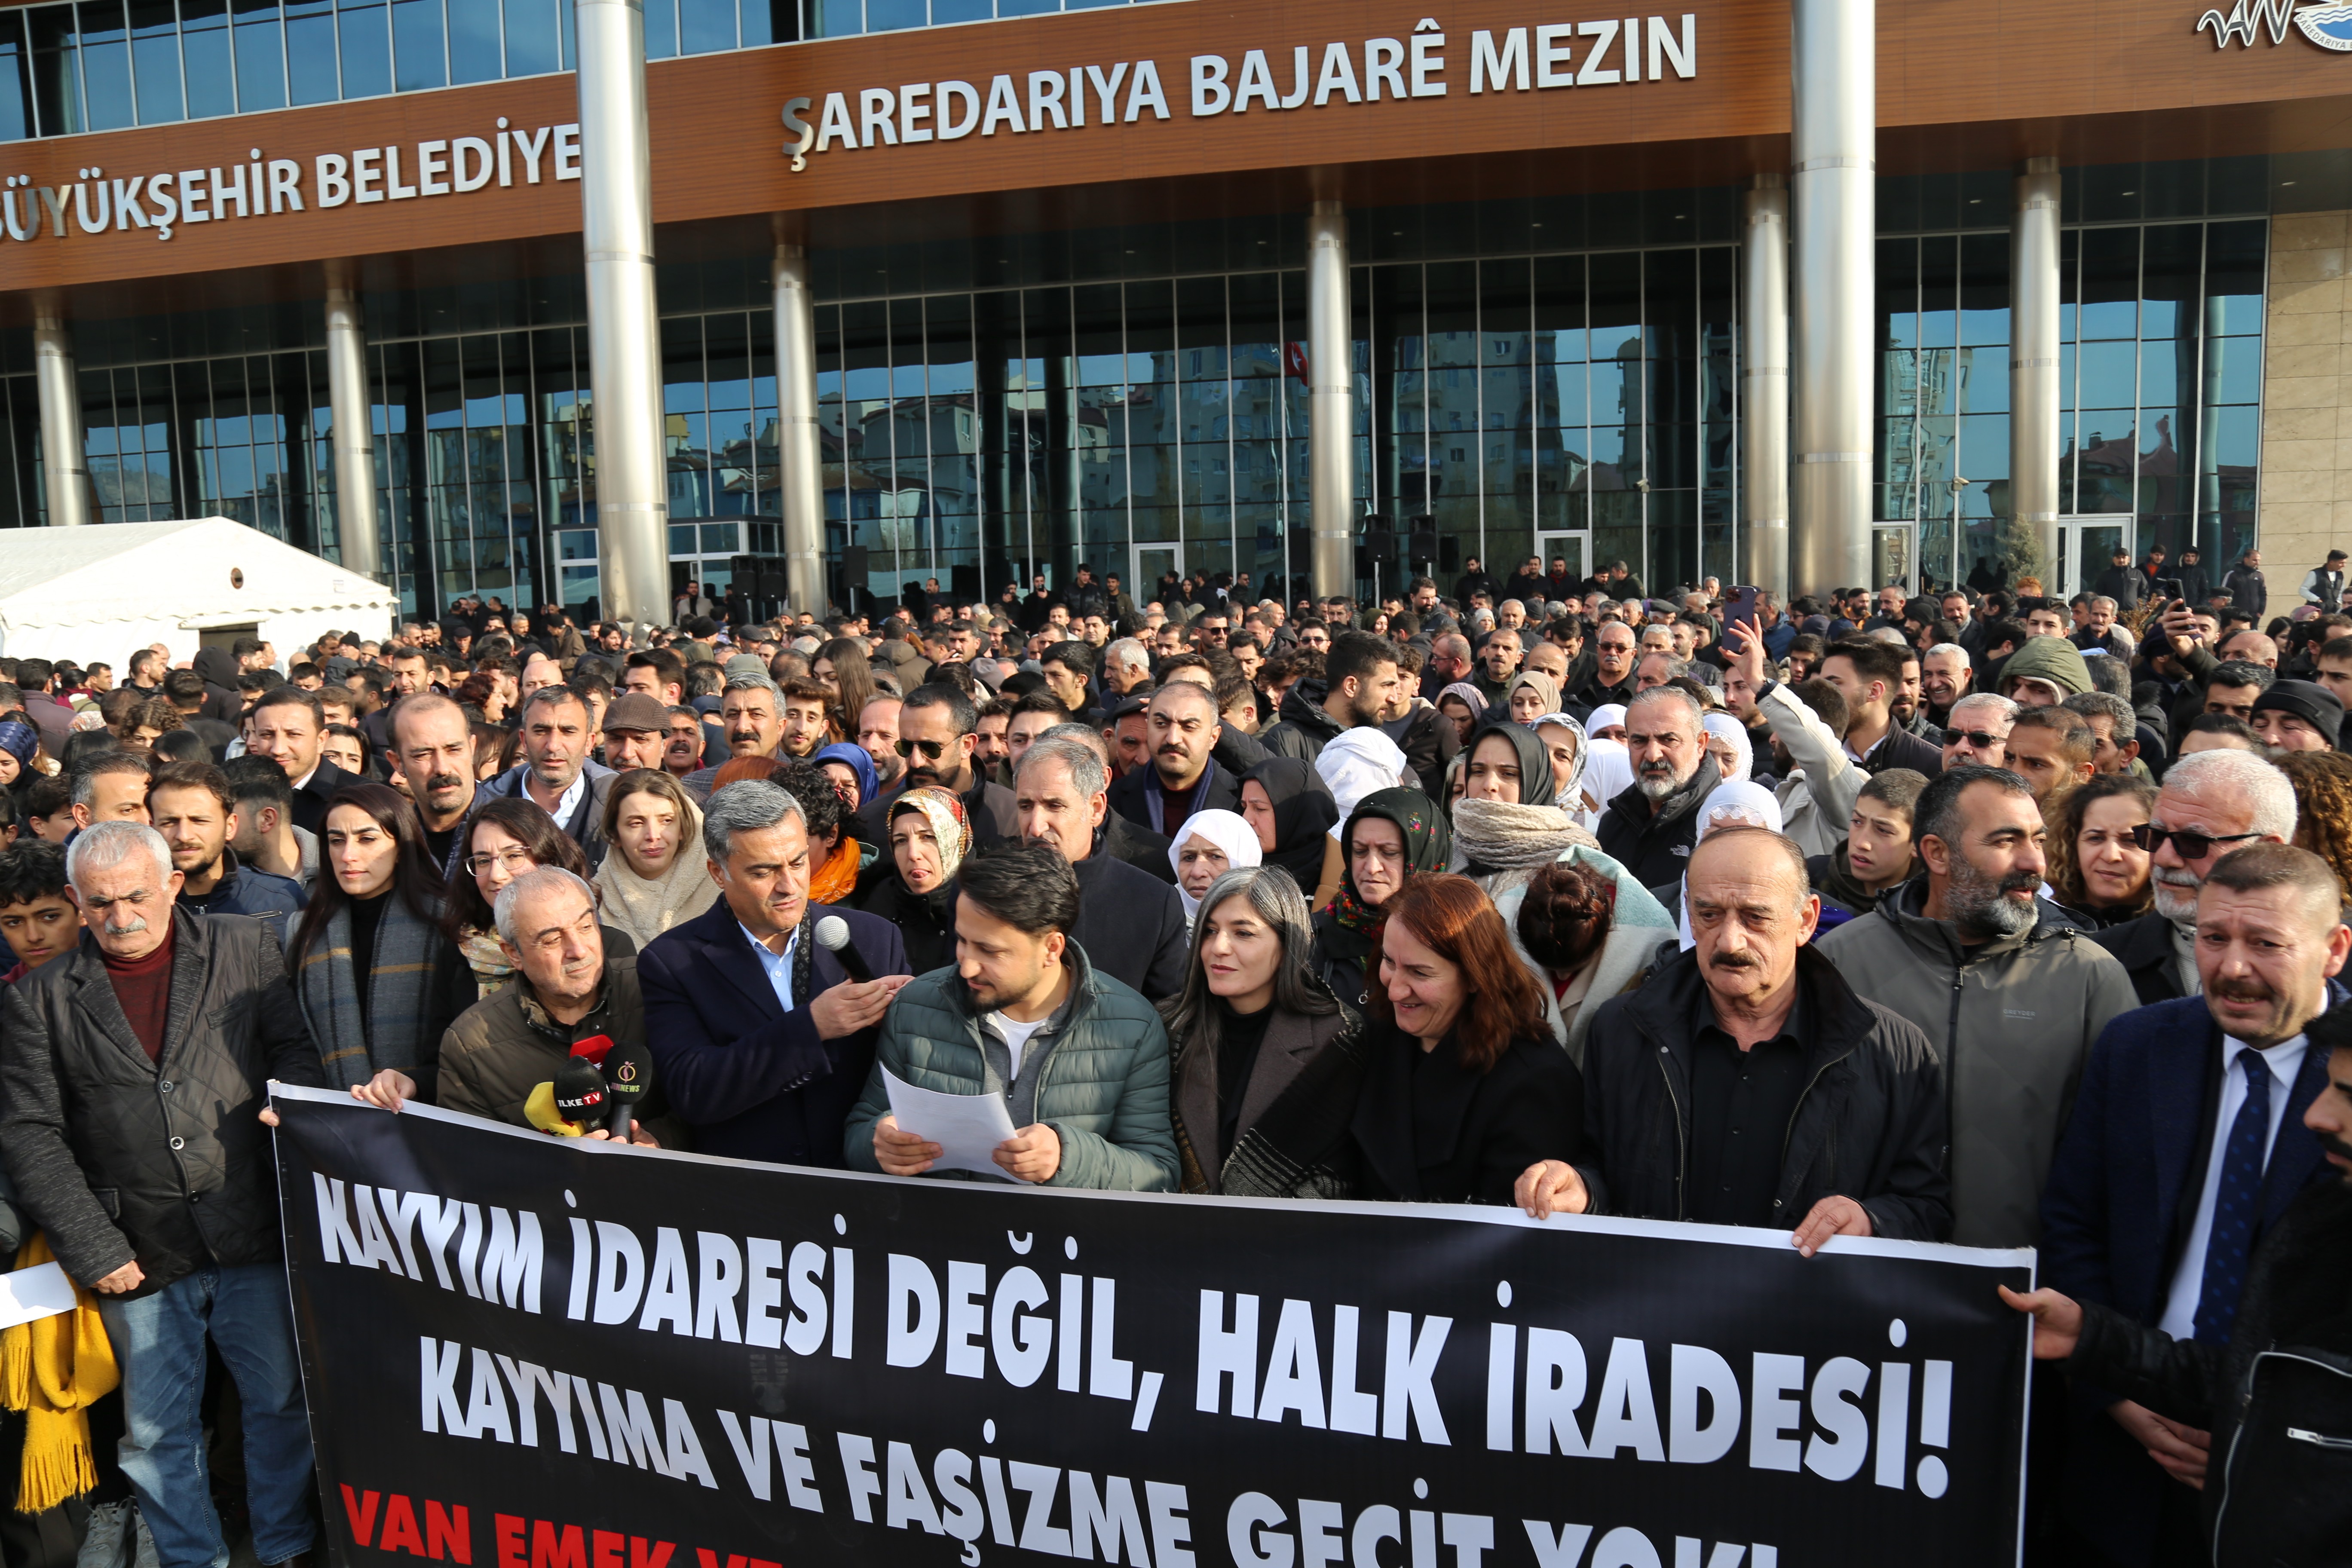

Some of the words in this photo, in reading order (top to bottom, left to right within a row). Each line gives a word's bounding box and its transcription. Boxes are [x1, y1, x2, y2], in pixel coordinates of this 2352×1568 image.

[781, 60, 1171, 172] ŞAREDARIYA
[1191, 18, 1447, 117] BAJARÊ
[1470, 14, 1696, 94] MEZIN
[0, 148, 305, 241] ÜYÜKŞEHİR
[2003, 1008, 2036, 1017] GREYDER
[313, 1172, 543, 1314] KAYYIM
[565, 1189, 854, 1359] İDARESİ
[887, 1231, 1164, 1432] DEĞİL,
[1196, 1289, 1453, 1446] HALK
[1487, 1280, 1952, 1499] İRADESİ!
[421, 1336, 719, 1489] KAYYIMA
[717, 1409, 824, 1513] VE
[837, 1419, 1197, 1568] FAŞİZME
[341, 1484, 472, 1565] VAN
